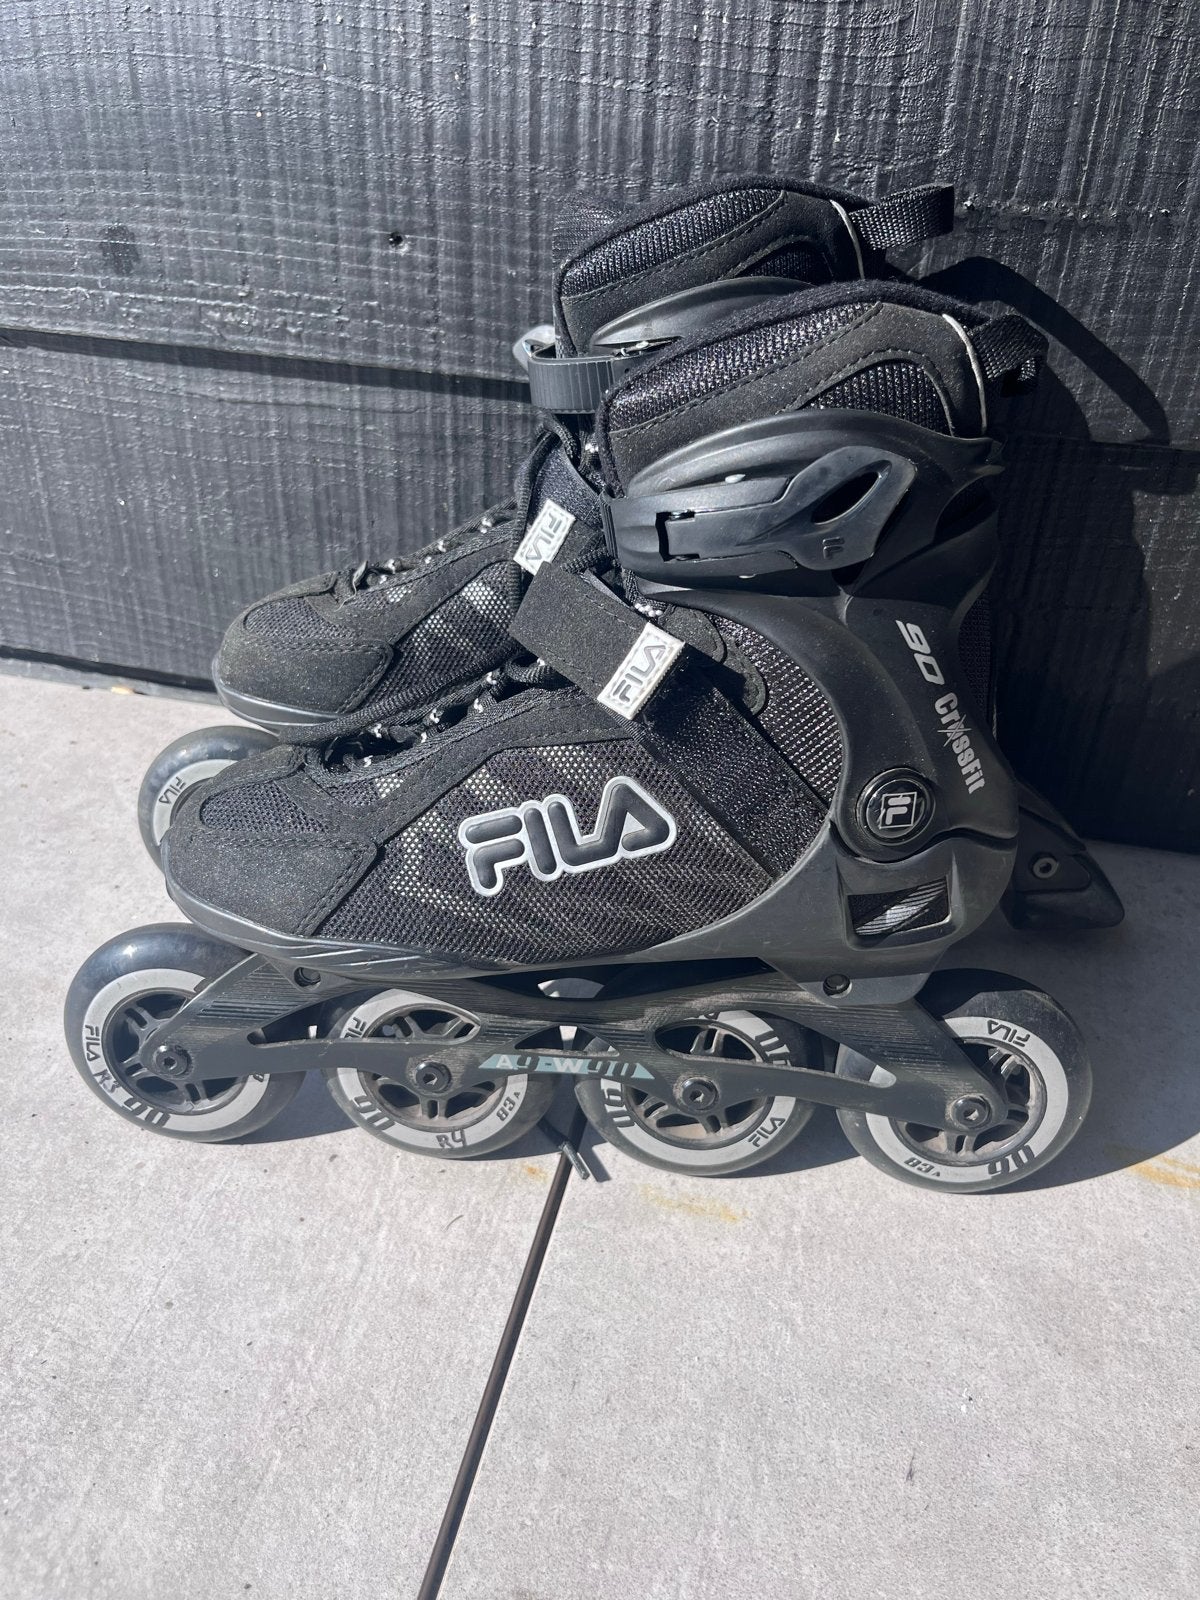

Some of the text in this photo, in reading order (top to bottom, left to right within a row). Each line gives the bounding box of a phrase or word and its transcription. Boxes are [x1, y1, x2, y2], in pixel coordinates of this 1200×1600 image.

[525, 512, 564, 562] FILA
[896, 620, 945, 686] 90
[612, 644, 668, 704] FILA
[158, 776, 187, 805] FILA
[458, 775, 677, 897] FILA
[84, 1024, 101, 1062] FILA
[986, 1018, 1031, 1048] FILA
[123, 1096, 172, 1128] 90
[354, 1095, 396, 1130] 90
[603, 1088, 639, 1128] 90
[748, 1116, 786, 1148] FILA
[987, 1144, 1036, 1177] 90
